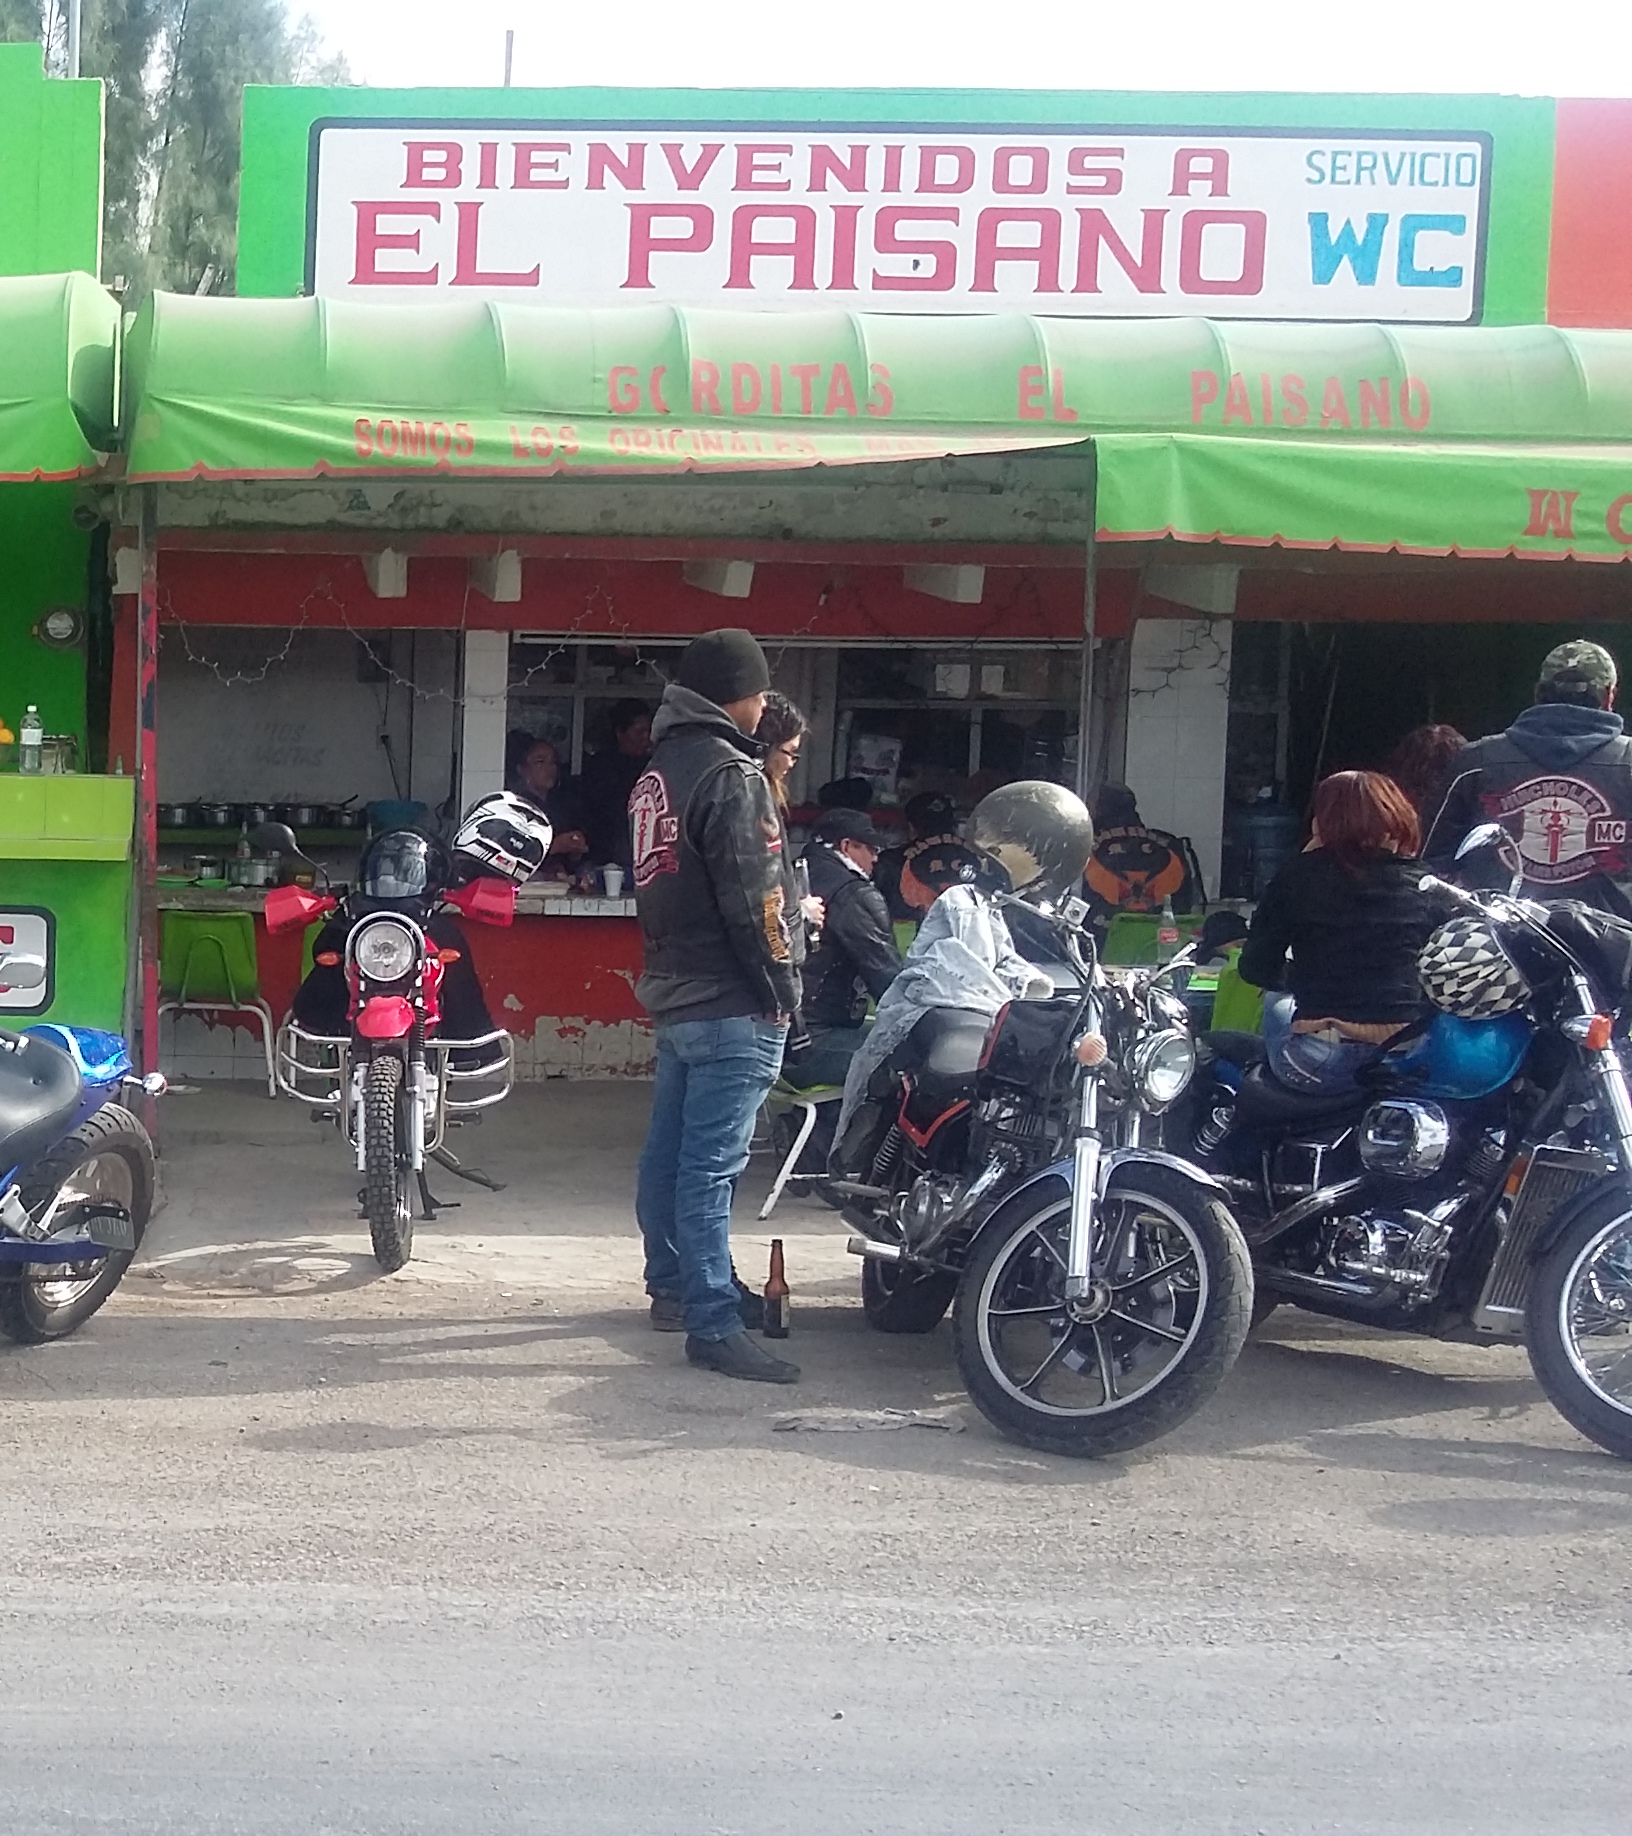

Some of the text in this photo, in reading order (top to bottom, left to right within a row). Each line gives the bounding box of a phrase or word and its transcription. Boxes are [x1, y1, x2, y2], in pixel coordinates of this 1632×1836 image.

[399, 141, 1231, 198] BIENVENIDOS A
[1305, 149, 1477, 188] SERVICIO
[347, 200, 1268, 296] EL PAISANO
[1307, 211, 1467, 288] WC
[1017, 365, 1079, 423] EL
[1190, 370, 1432, 432] PAISANO
[354, 418, 475, 458] SOMOS
[509, 425, 580, 458] LOS
[1597, 823, 1624, 841] MC
